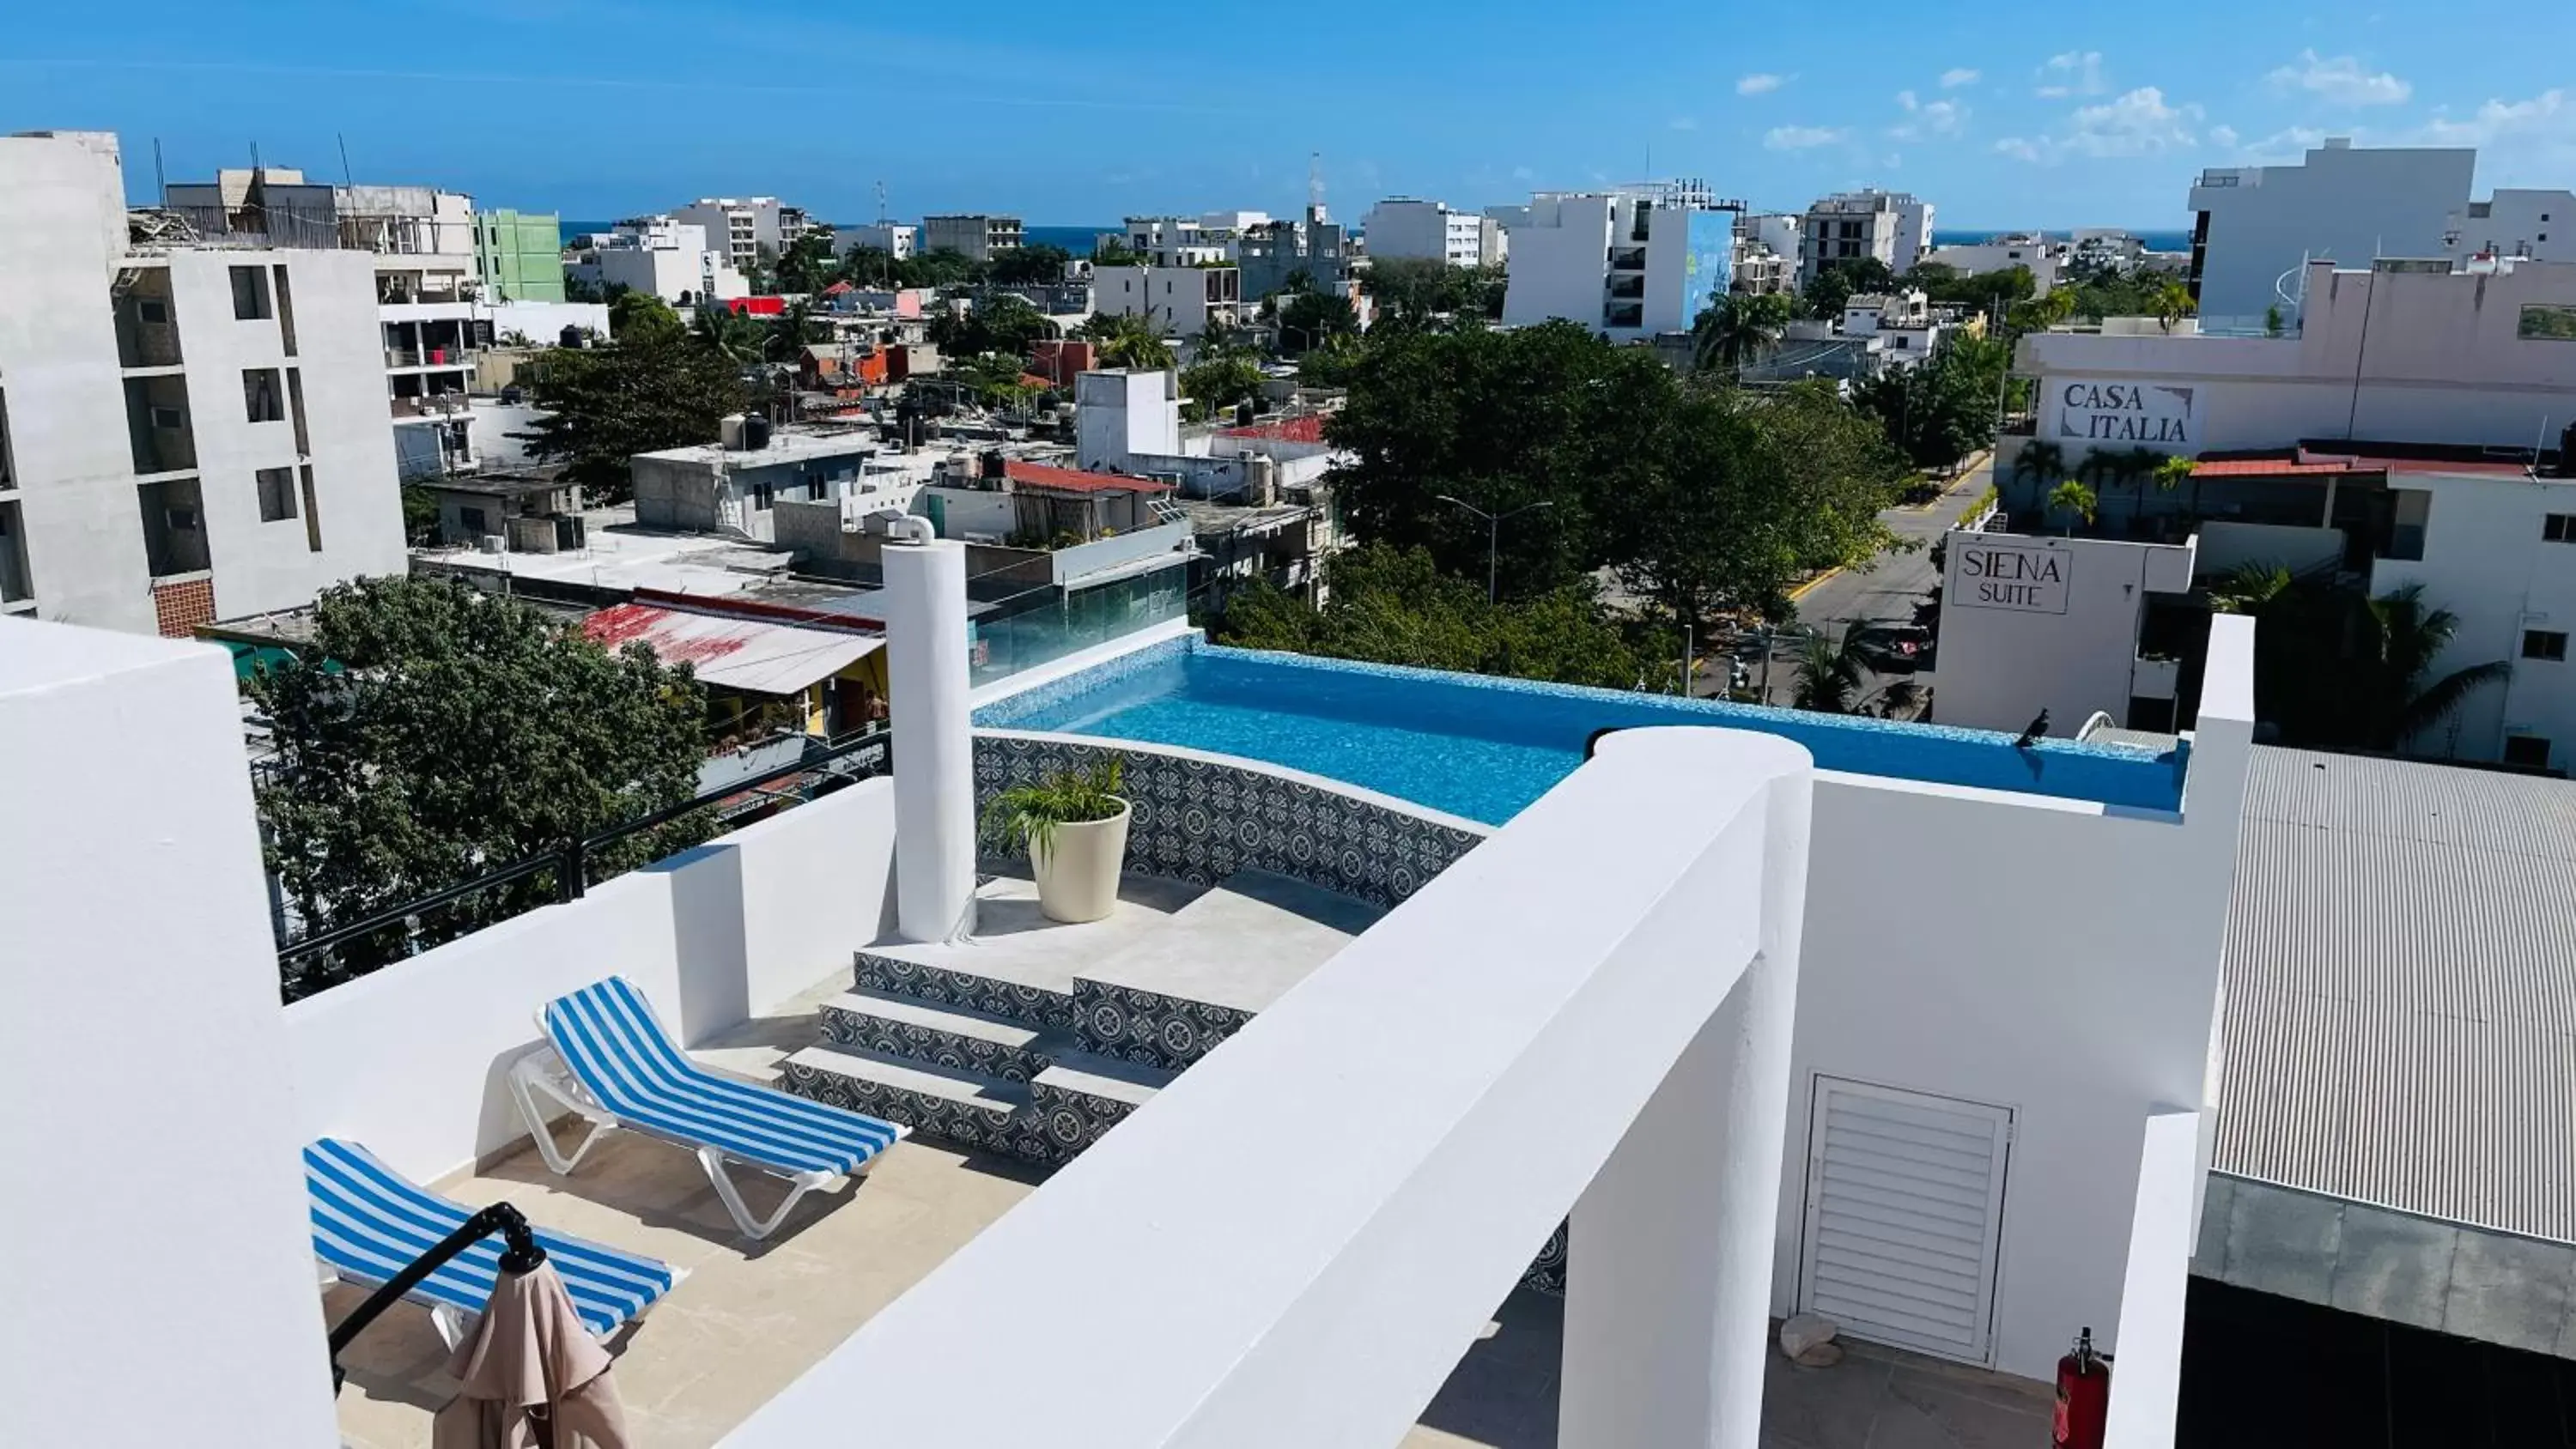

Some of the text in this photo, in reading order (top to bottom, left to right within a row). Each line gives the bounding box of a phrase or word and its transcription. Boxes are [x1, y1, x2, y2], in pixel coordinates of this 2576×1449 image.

[2064, 384, 2143, 409] CASA
[2088, 415, 2187, 442] ITALIA
[1964, 550, 2061, 582] SIENA
[1978, 583, 2043, 606] SUITE
